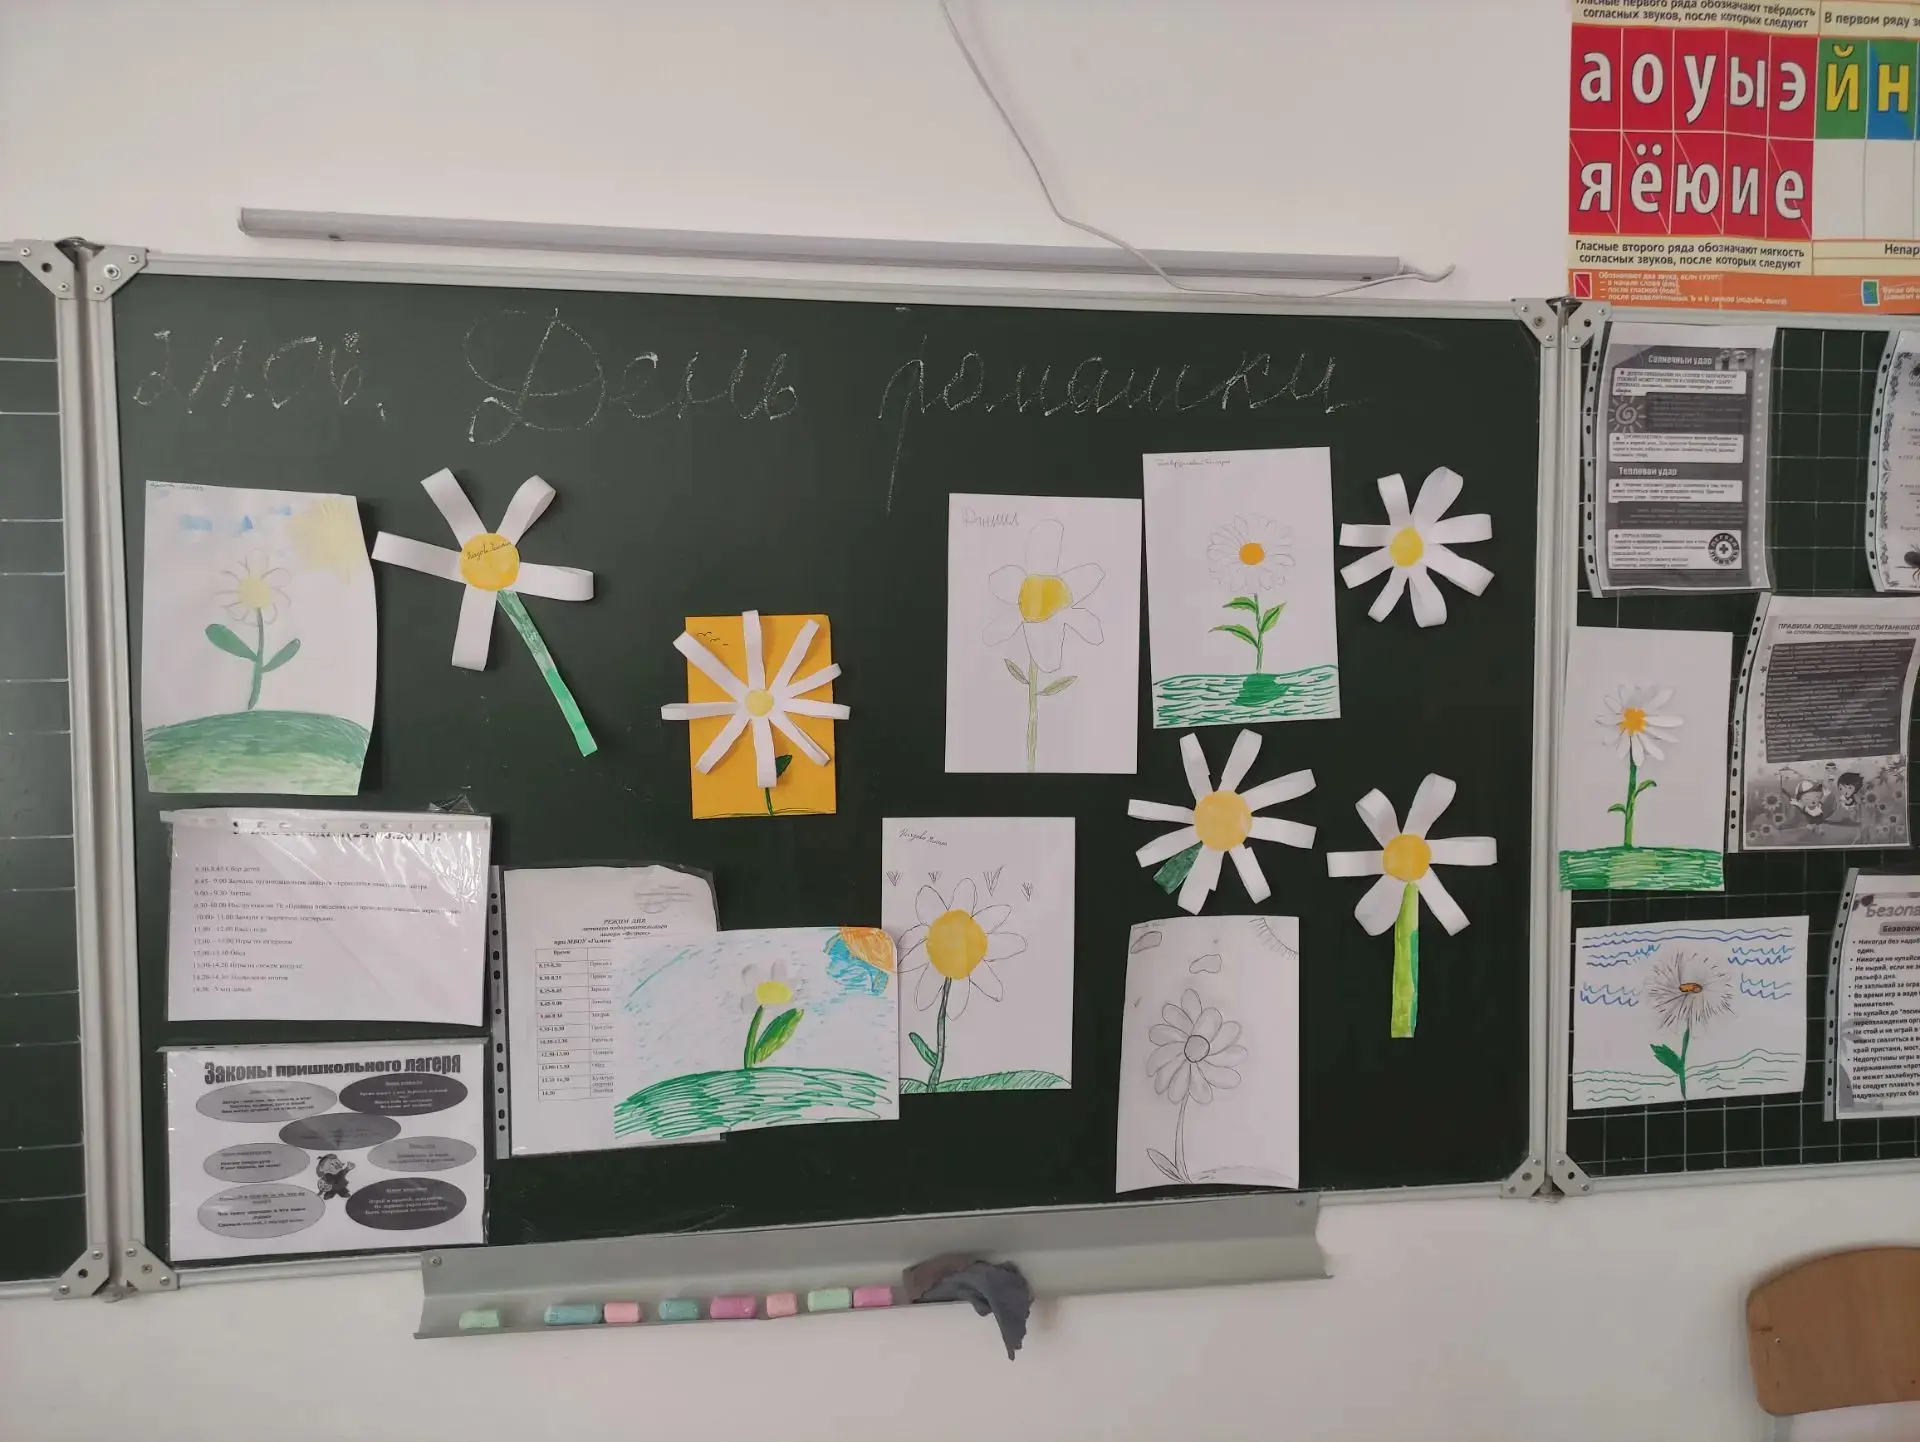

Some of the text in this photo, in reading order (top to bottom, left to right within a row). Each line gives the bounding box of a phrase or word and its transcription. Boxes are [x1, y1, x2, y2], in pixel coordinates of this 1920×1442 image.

[1671, 0, 1697, 9] ряда
[1700, 0, 1761, 12] обозначают
[1763, 4, 1816, 16] твёрдость
[1583, 8, 1808, 30] согласных звуков, после которых следуют
[1824, 12, 1832, 24] В
[1836, 15, 1879, 26] первом
[1883, 16, 1911, 28] ряду
[1576, 240, 1805, 258] Гласные второго ряда обозначают мягкость
[1579, 253, 1801, 271] согласных звуков, после которых следуют
[1648, 354, 1712, 366] Солнечный удар
[463, 307, 1360, 516] День ромашки
[1658, 468, 1677, 477] удар
[1865, 903, 1920, 918] Безопа
[204, 1054, 461, 1085] Законы пришкольного лагеря
